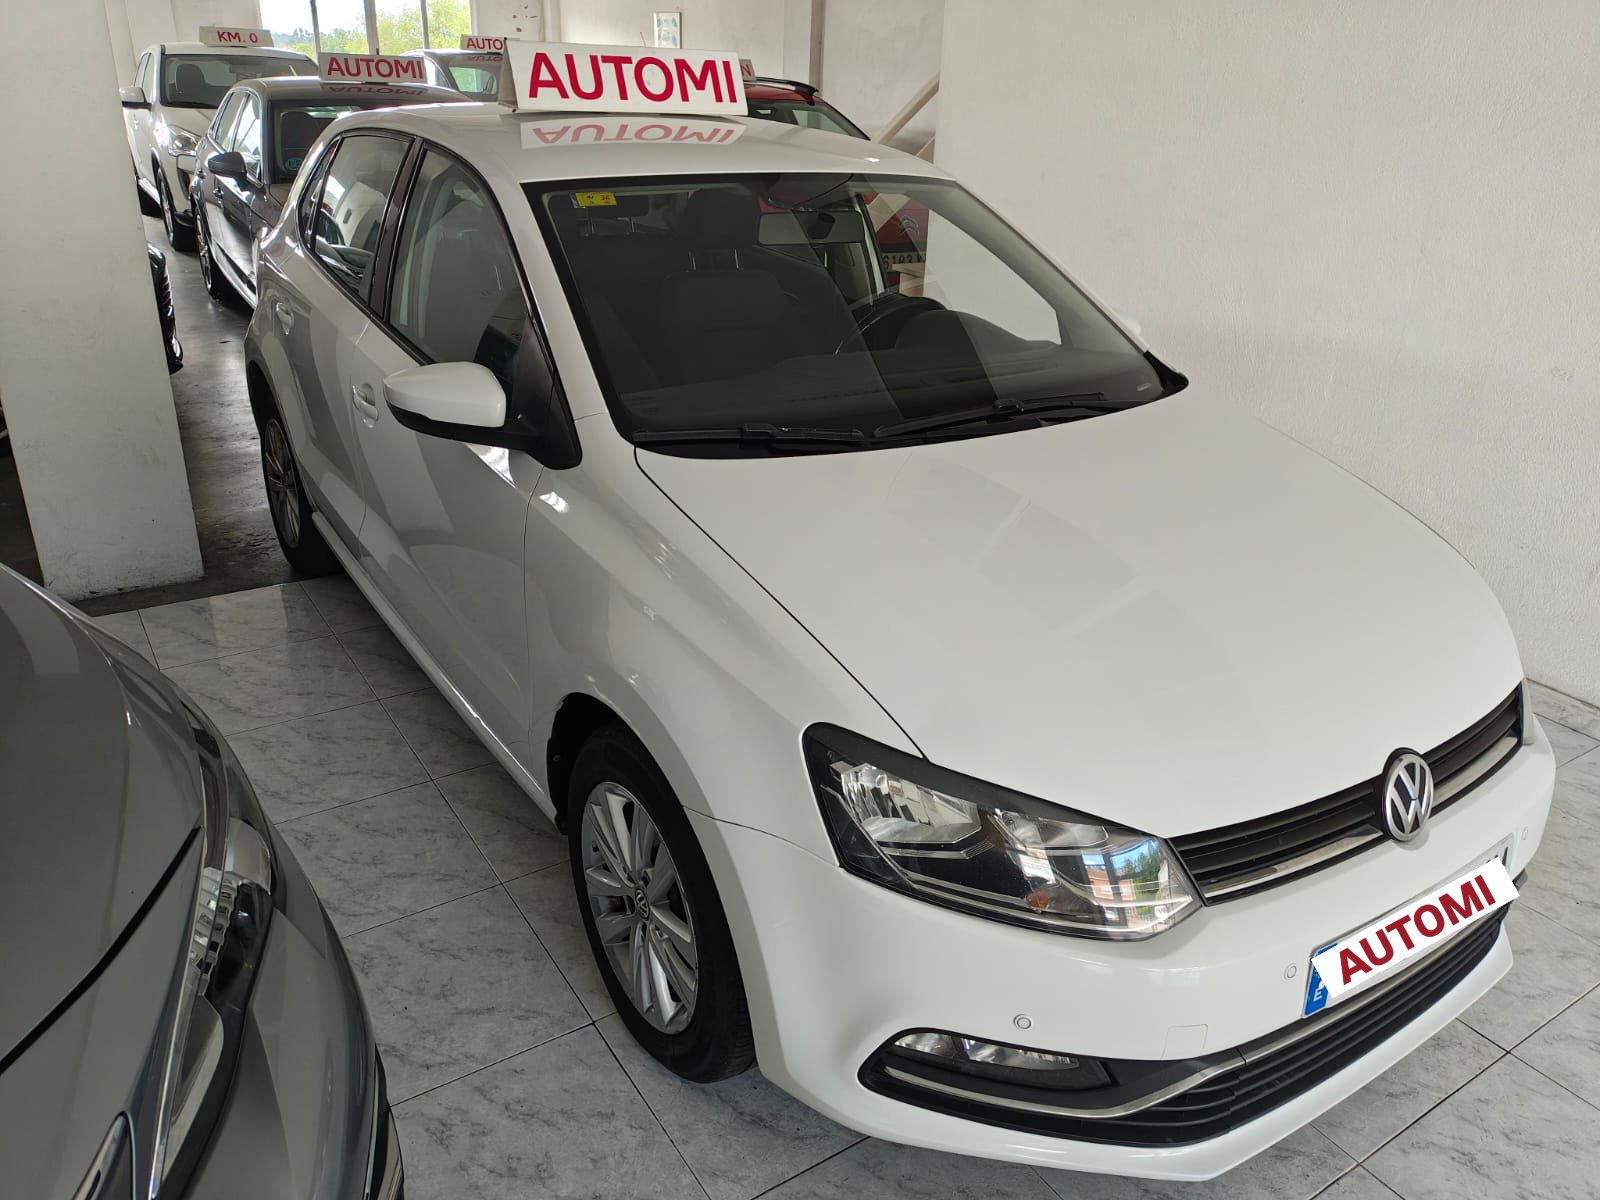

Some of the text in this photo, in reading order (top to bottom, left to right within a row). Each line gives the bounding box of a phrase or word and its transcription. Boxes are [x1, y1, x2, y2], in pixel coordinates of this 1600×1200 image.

[327, 57, 424, 79] AUTOMI
[529, 52, 738, 104] AUTOMI
[1384, 752, 1435, 842] VW
